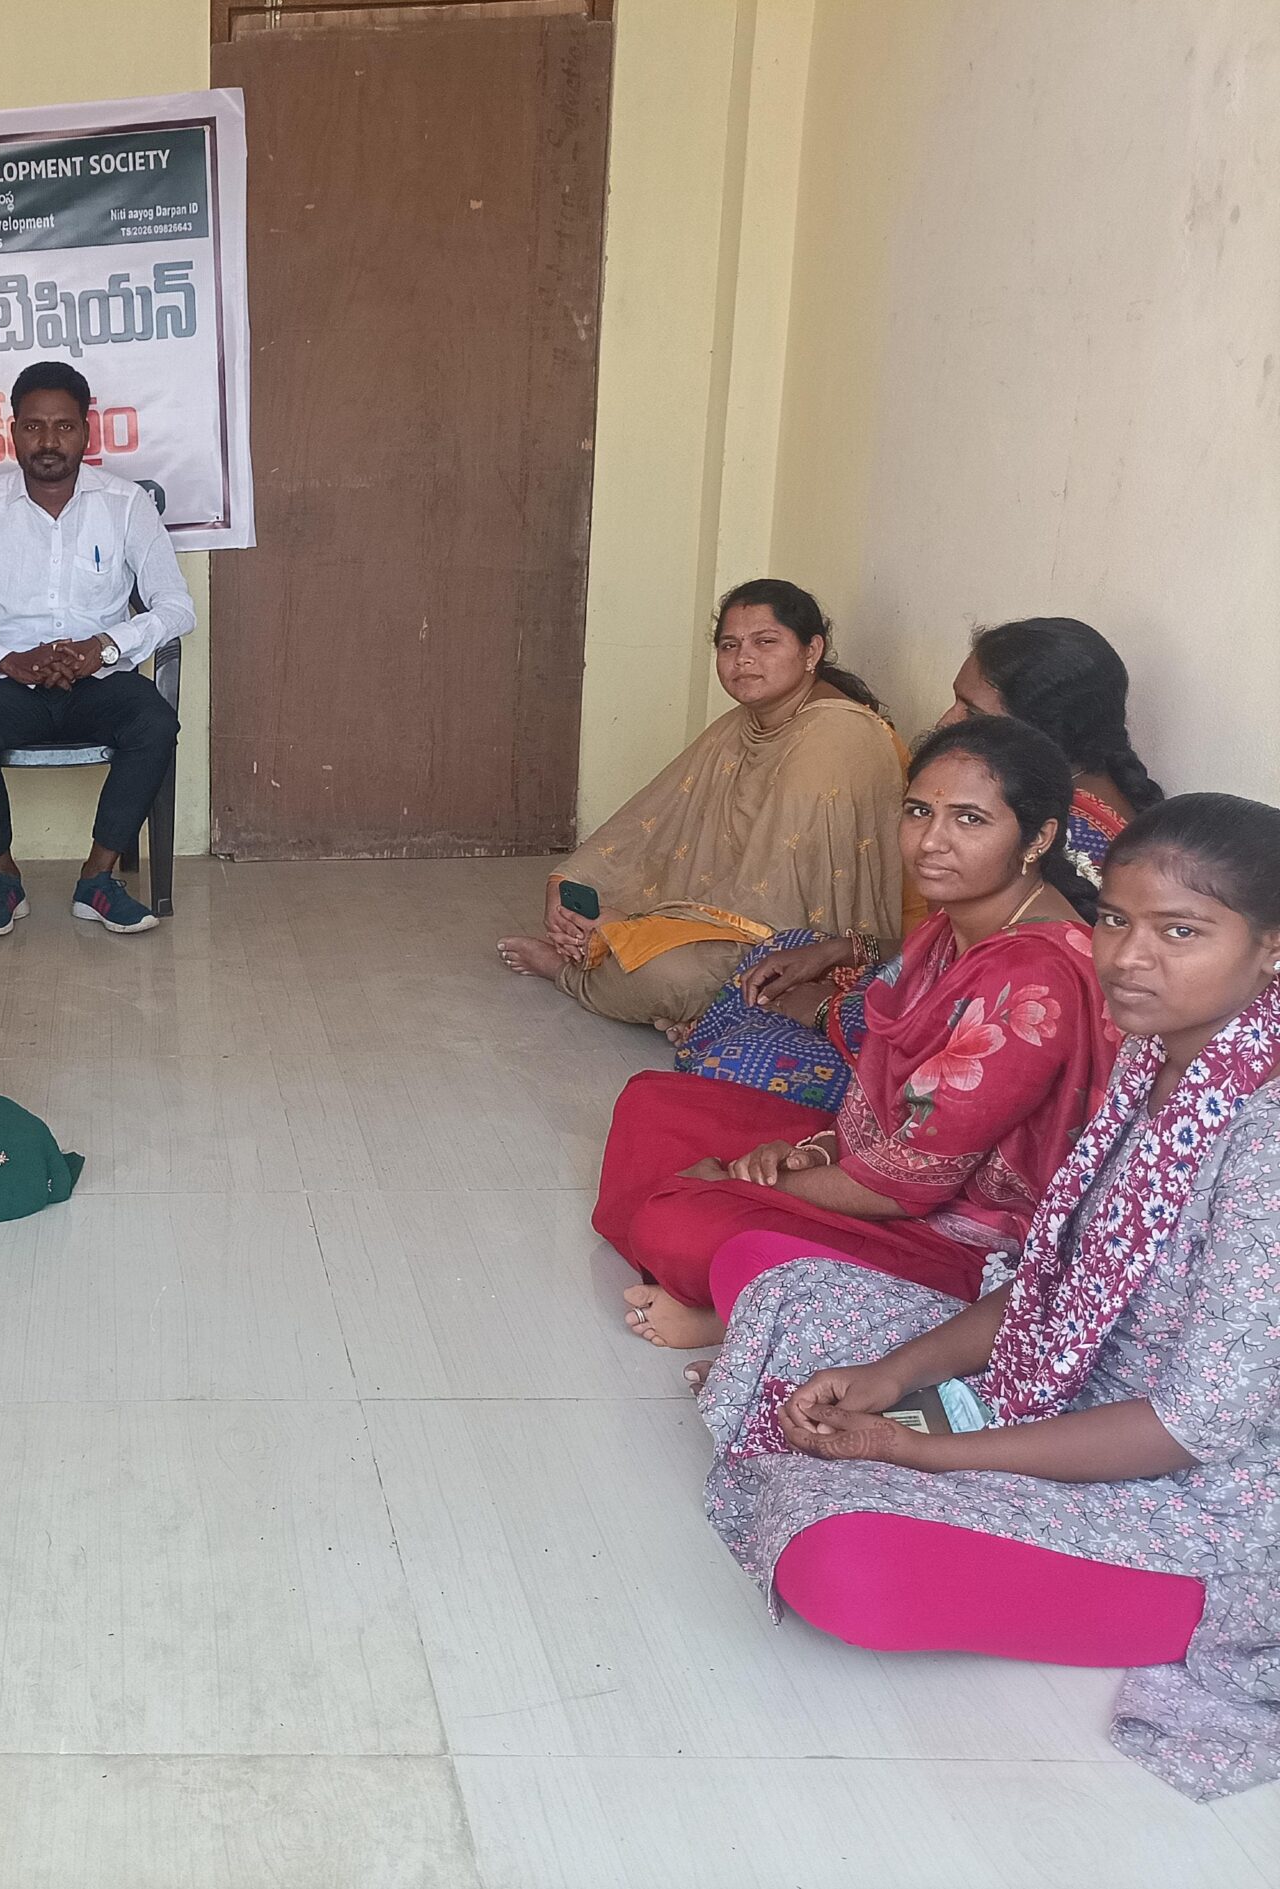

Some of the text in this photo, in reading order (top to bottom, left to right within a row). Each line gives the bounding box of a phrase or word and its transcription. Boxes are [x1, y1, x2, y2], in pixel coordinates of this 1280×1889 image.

[89, 149, 170, 176] SOCIETY
[110, 202, 198, 221] Niti aayog Darpan ID
